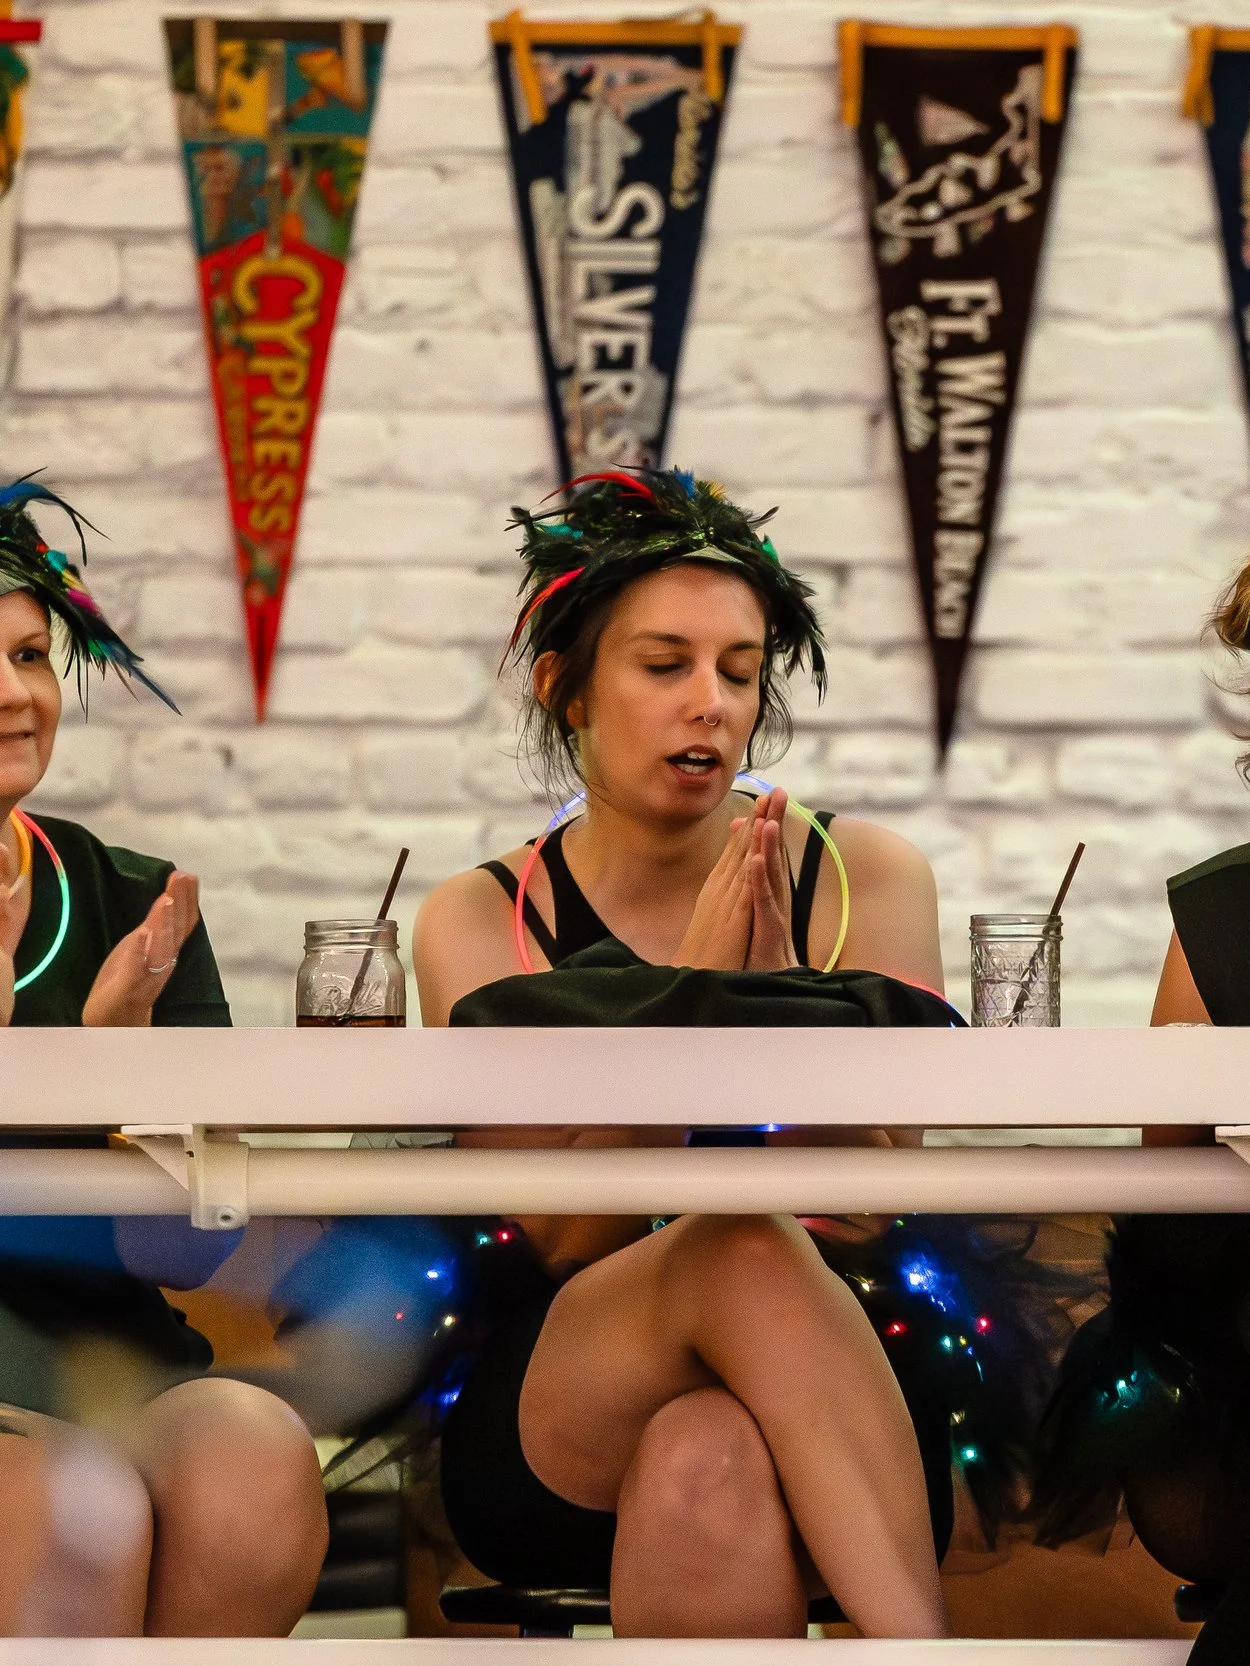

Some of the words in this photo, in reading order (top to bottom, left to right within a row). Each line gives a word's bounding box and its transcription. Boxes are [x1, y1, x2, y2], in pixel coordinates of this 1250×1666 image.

[231, 254, 323, 532] CYPRESS
[567, 181, 666, 406] SILVER
[934, 350, 1007, 525] WALTON
